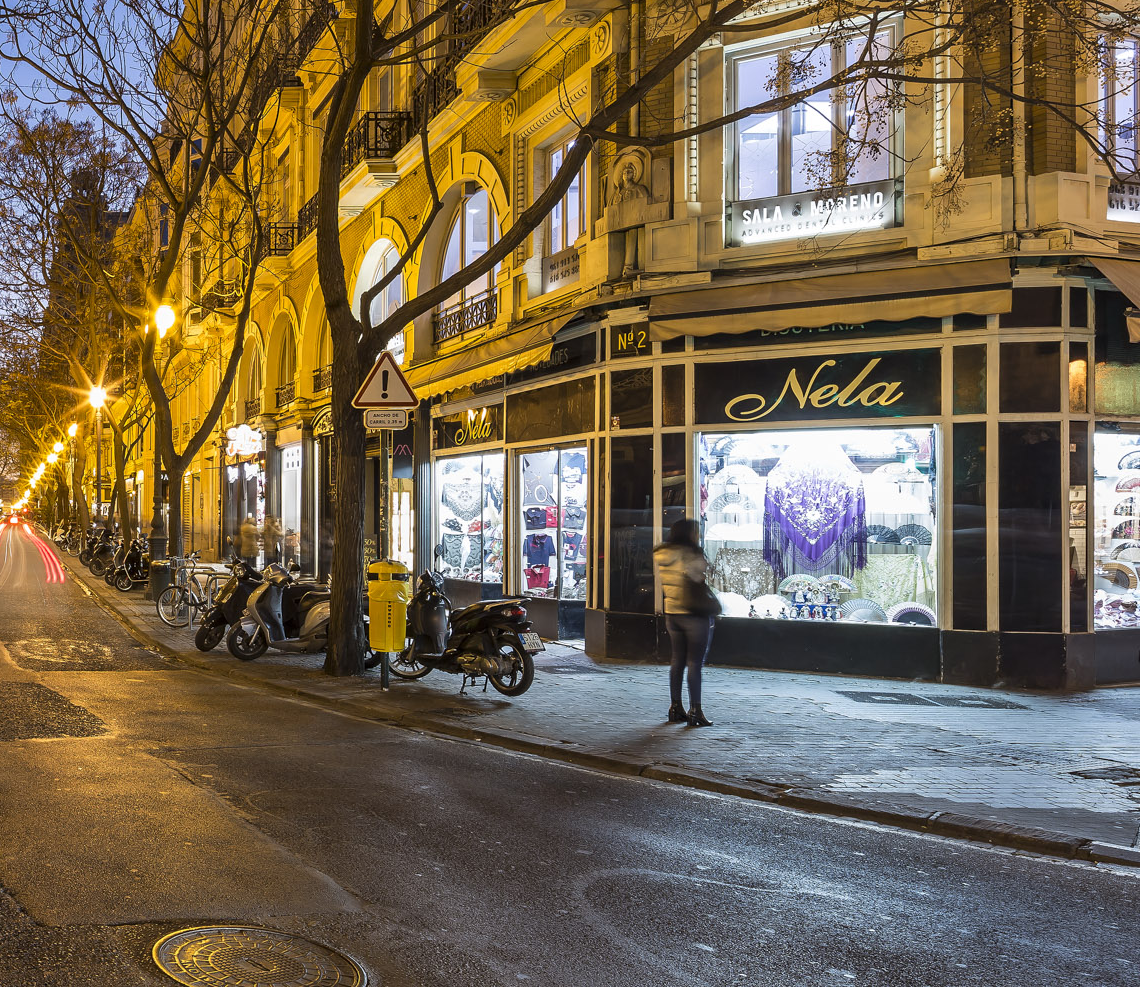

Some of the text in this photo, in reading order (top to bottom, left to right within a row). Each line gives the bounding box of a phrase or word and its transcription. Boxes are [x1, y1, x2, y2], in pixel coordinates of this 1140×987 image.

[742, 191, 884, 225] SALA & MORENO
[741, 211, 885, 237] ADVANCED DENTL CLINICS
[637, 330, 647, 348] 2
[760, 323, 865, 337] UERIA
[724, 357, 904, 422] Nela
[454, 407, 493, 447] Nela
